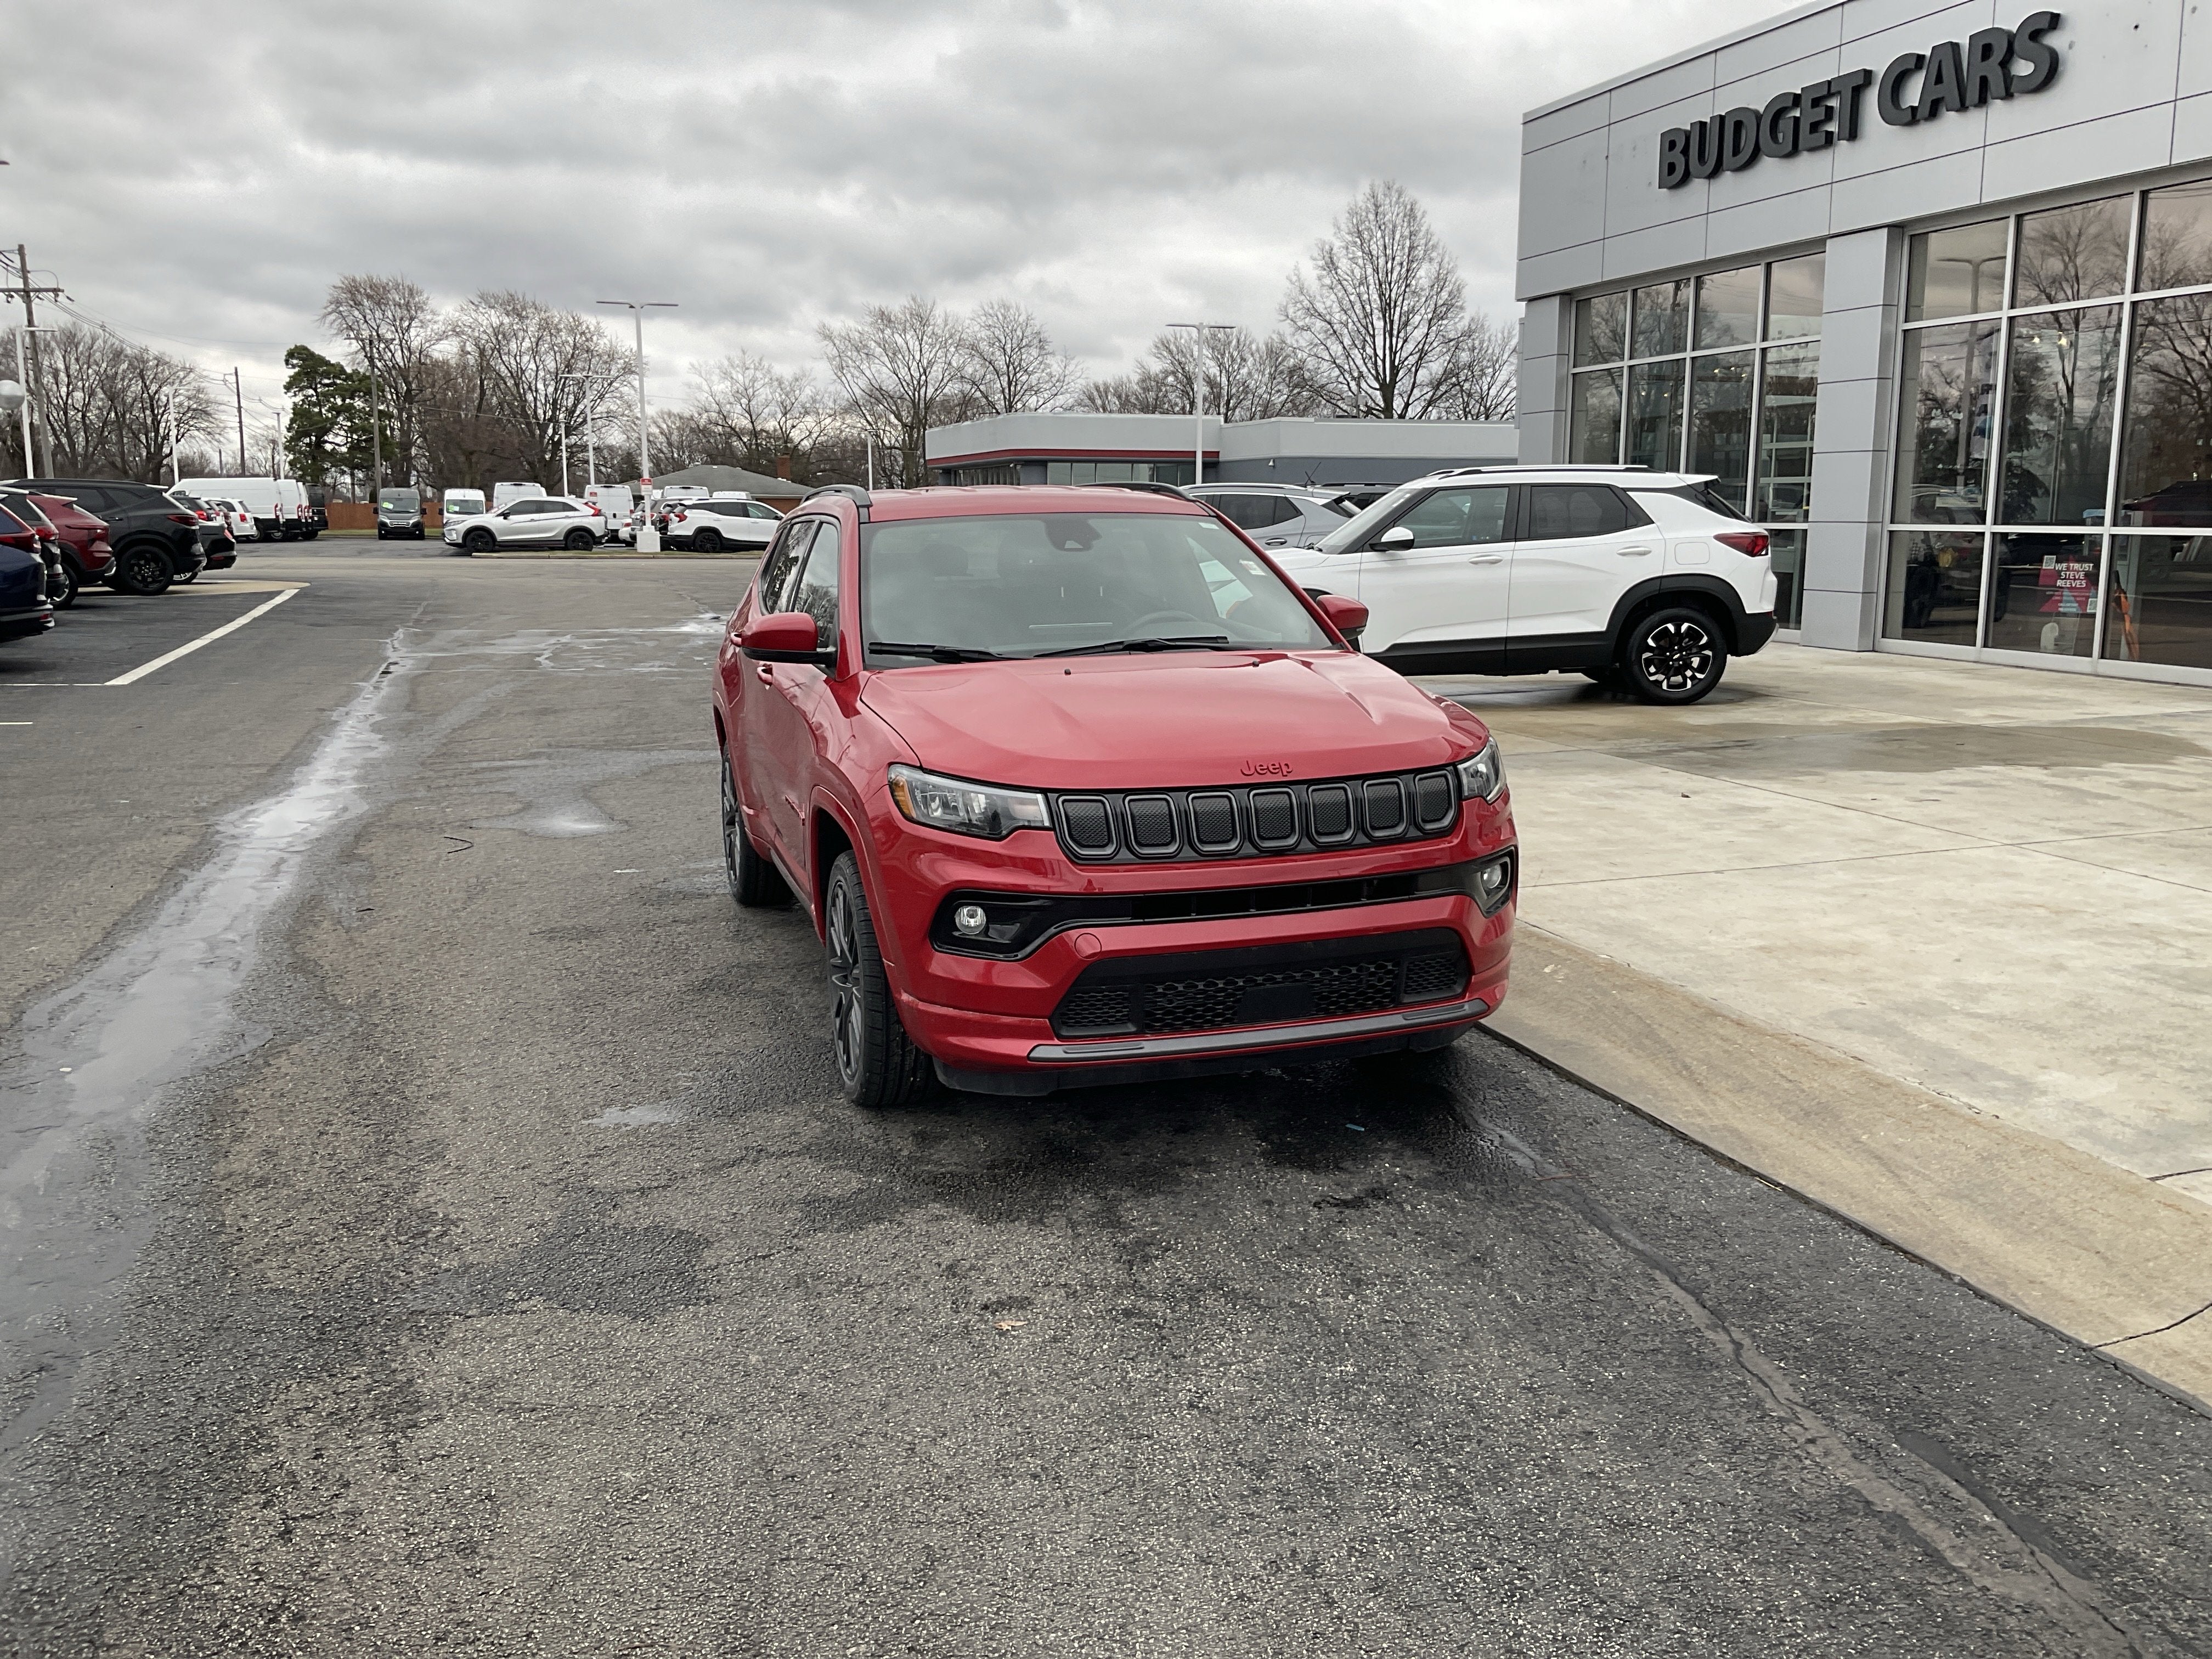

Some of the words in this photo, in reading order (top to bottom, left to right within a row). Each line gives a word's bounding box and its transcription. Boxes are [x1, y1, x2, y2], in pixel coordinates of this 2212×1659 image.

[1658, 67, 1872, 189] BUDGET
[1877, 11, 2061, 127] CARS
[2055, 563, 2068, 571] WE
[2069, 563, 2094, 571] TRUST
[2061, 571, 2085, 579] STEVE
[2056, 579, 2086, 588] REEVES
[1240, 760, 1293, 777] Jeep
